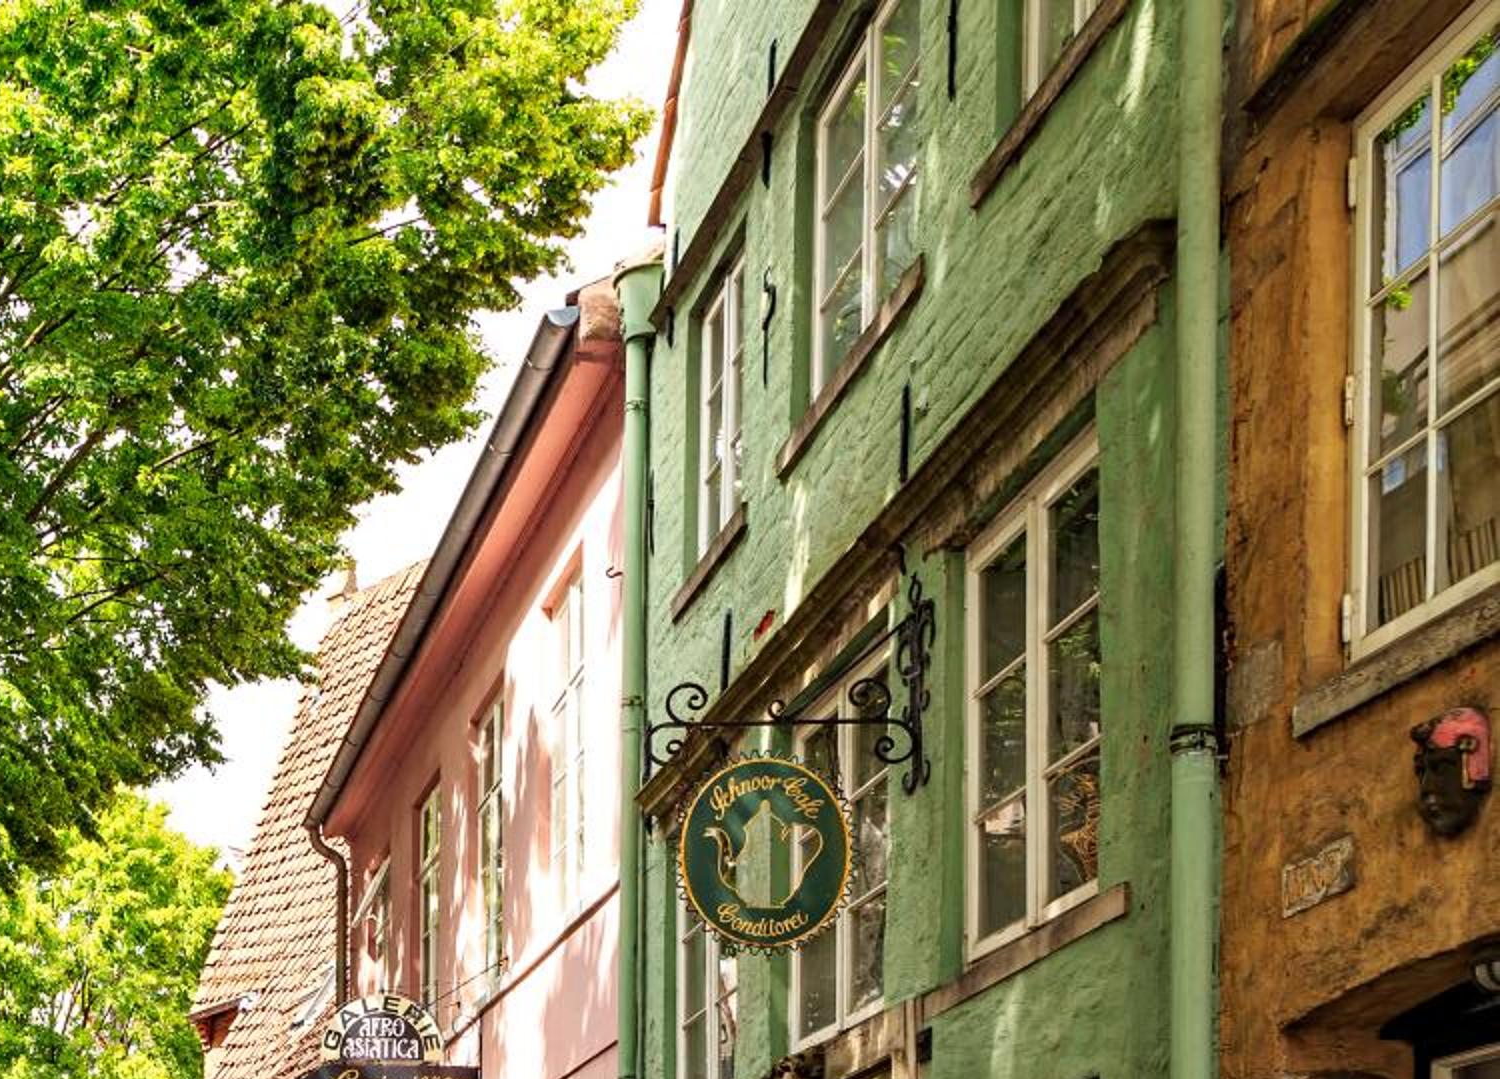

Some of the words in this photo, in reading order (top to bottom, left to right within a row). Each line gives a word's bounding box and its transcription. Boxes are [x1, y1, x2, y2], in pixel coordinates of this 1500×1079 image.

[709, 775, 780, 821] Schnoor
[717, 903, 809, 937] Conditorei
[323, 995, 441, 1051] GALERIE
[359, 1017, 405, 1037] AFRO
[343, 1037, 419, 1059] ASIATICA
